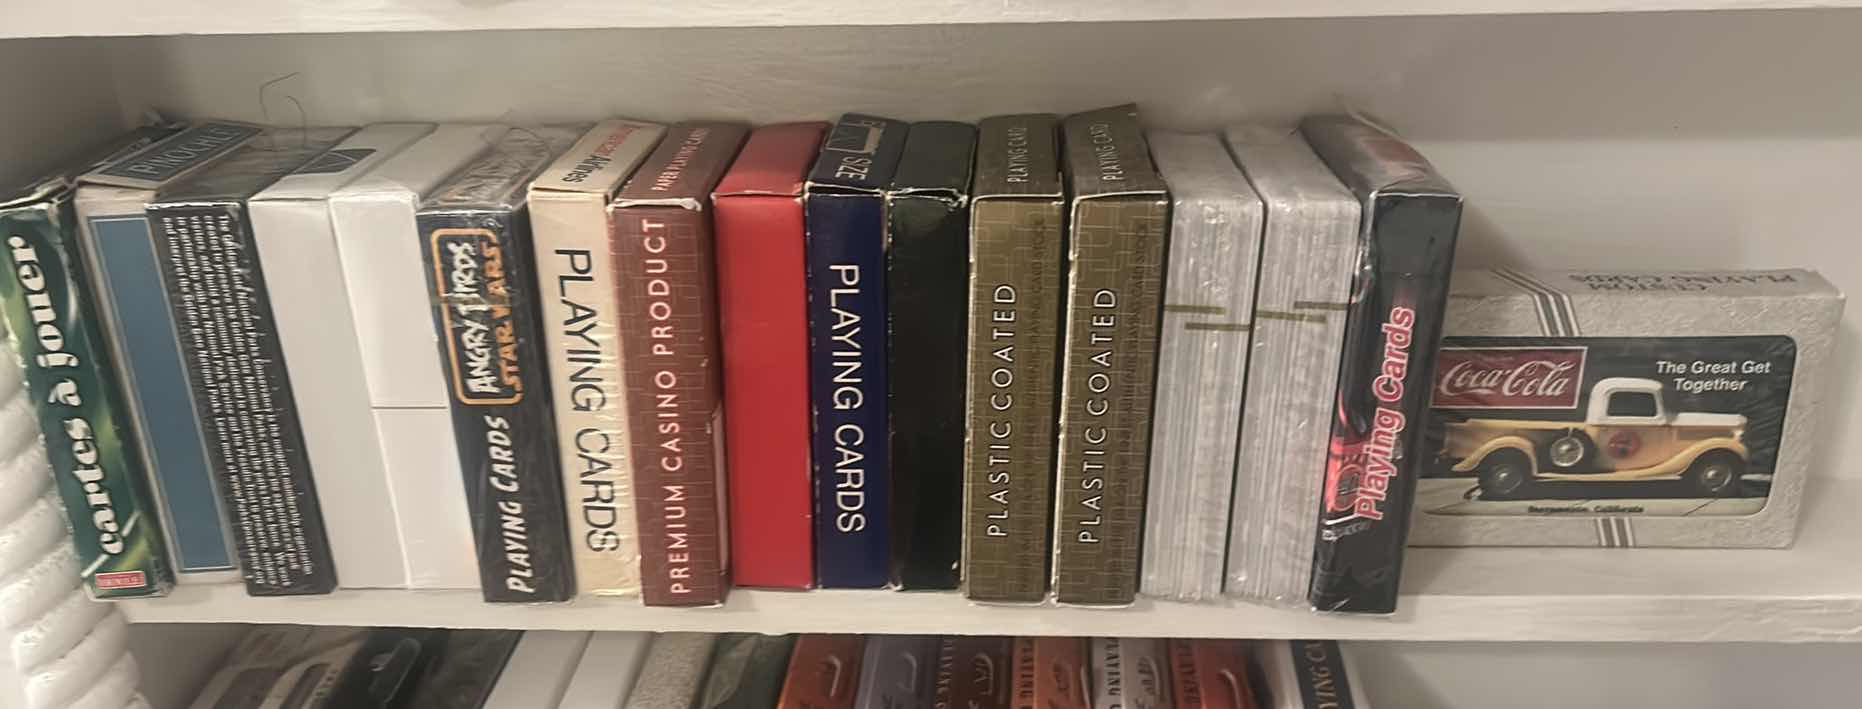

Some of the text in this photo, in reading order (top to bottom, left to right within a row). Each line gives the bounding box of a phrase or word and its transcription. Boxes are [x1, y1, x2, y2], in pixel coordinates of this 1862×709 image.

[562, 155, 611, 183] Airlines
[835, 156, 872, 180] SIZE
[1007, 148, 1029, 183] PLAYING
[1096, 145, 1126, 181] PLAYING
[8, 236, 79, 367] jouer
[236, 292, 254, 329] National
[48, 378, 82, 407] à
[462, 319, 501, 393] ANGRY
[495, 320, 523, 393] STAR
[1656, 360, 1773, 374] The Great Get
[1672, 377, 1748, 394] Together
[555, 249, 620, 552] PLAYING CARDS
[642, 218, 692, 594] PREMIUM CASINO PRODUCT
[829, 264, 866, 533] PLAYING CARDS
[986, 284, 1016, 537] PLASTIC COATED
[1079, 289, 1117, 544] PLASTIC COATED
[1353, 306, 1416, 521] Playing Cards
[64, 418, 124, 554] cartes
[484, 415, 536, 593] PLAYING CARDS
